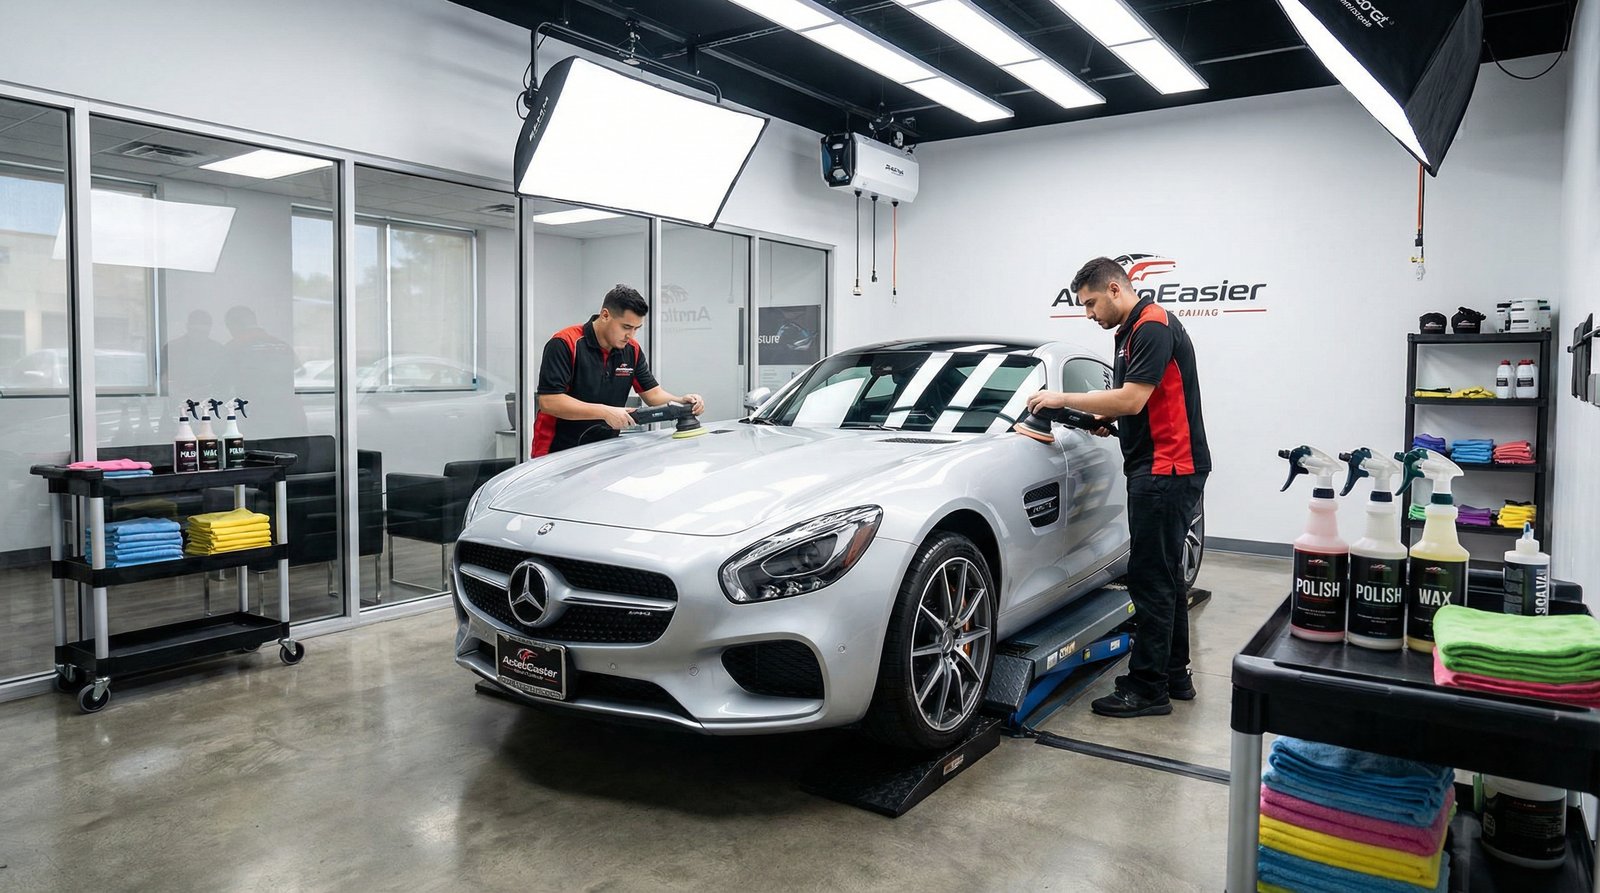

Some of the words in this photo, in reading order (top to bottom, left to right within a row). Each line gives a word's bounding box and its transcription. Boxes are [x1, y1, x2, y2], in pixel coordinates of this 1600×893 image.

[1296, 577, 1340, 598] POLISH
[1356, 583, 1402, 603] POLISH
[1419, 588, 1452, 607] WAX
